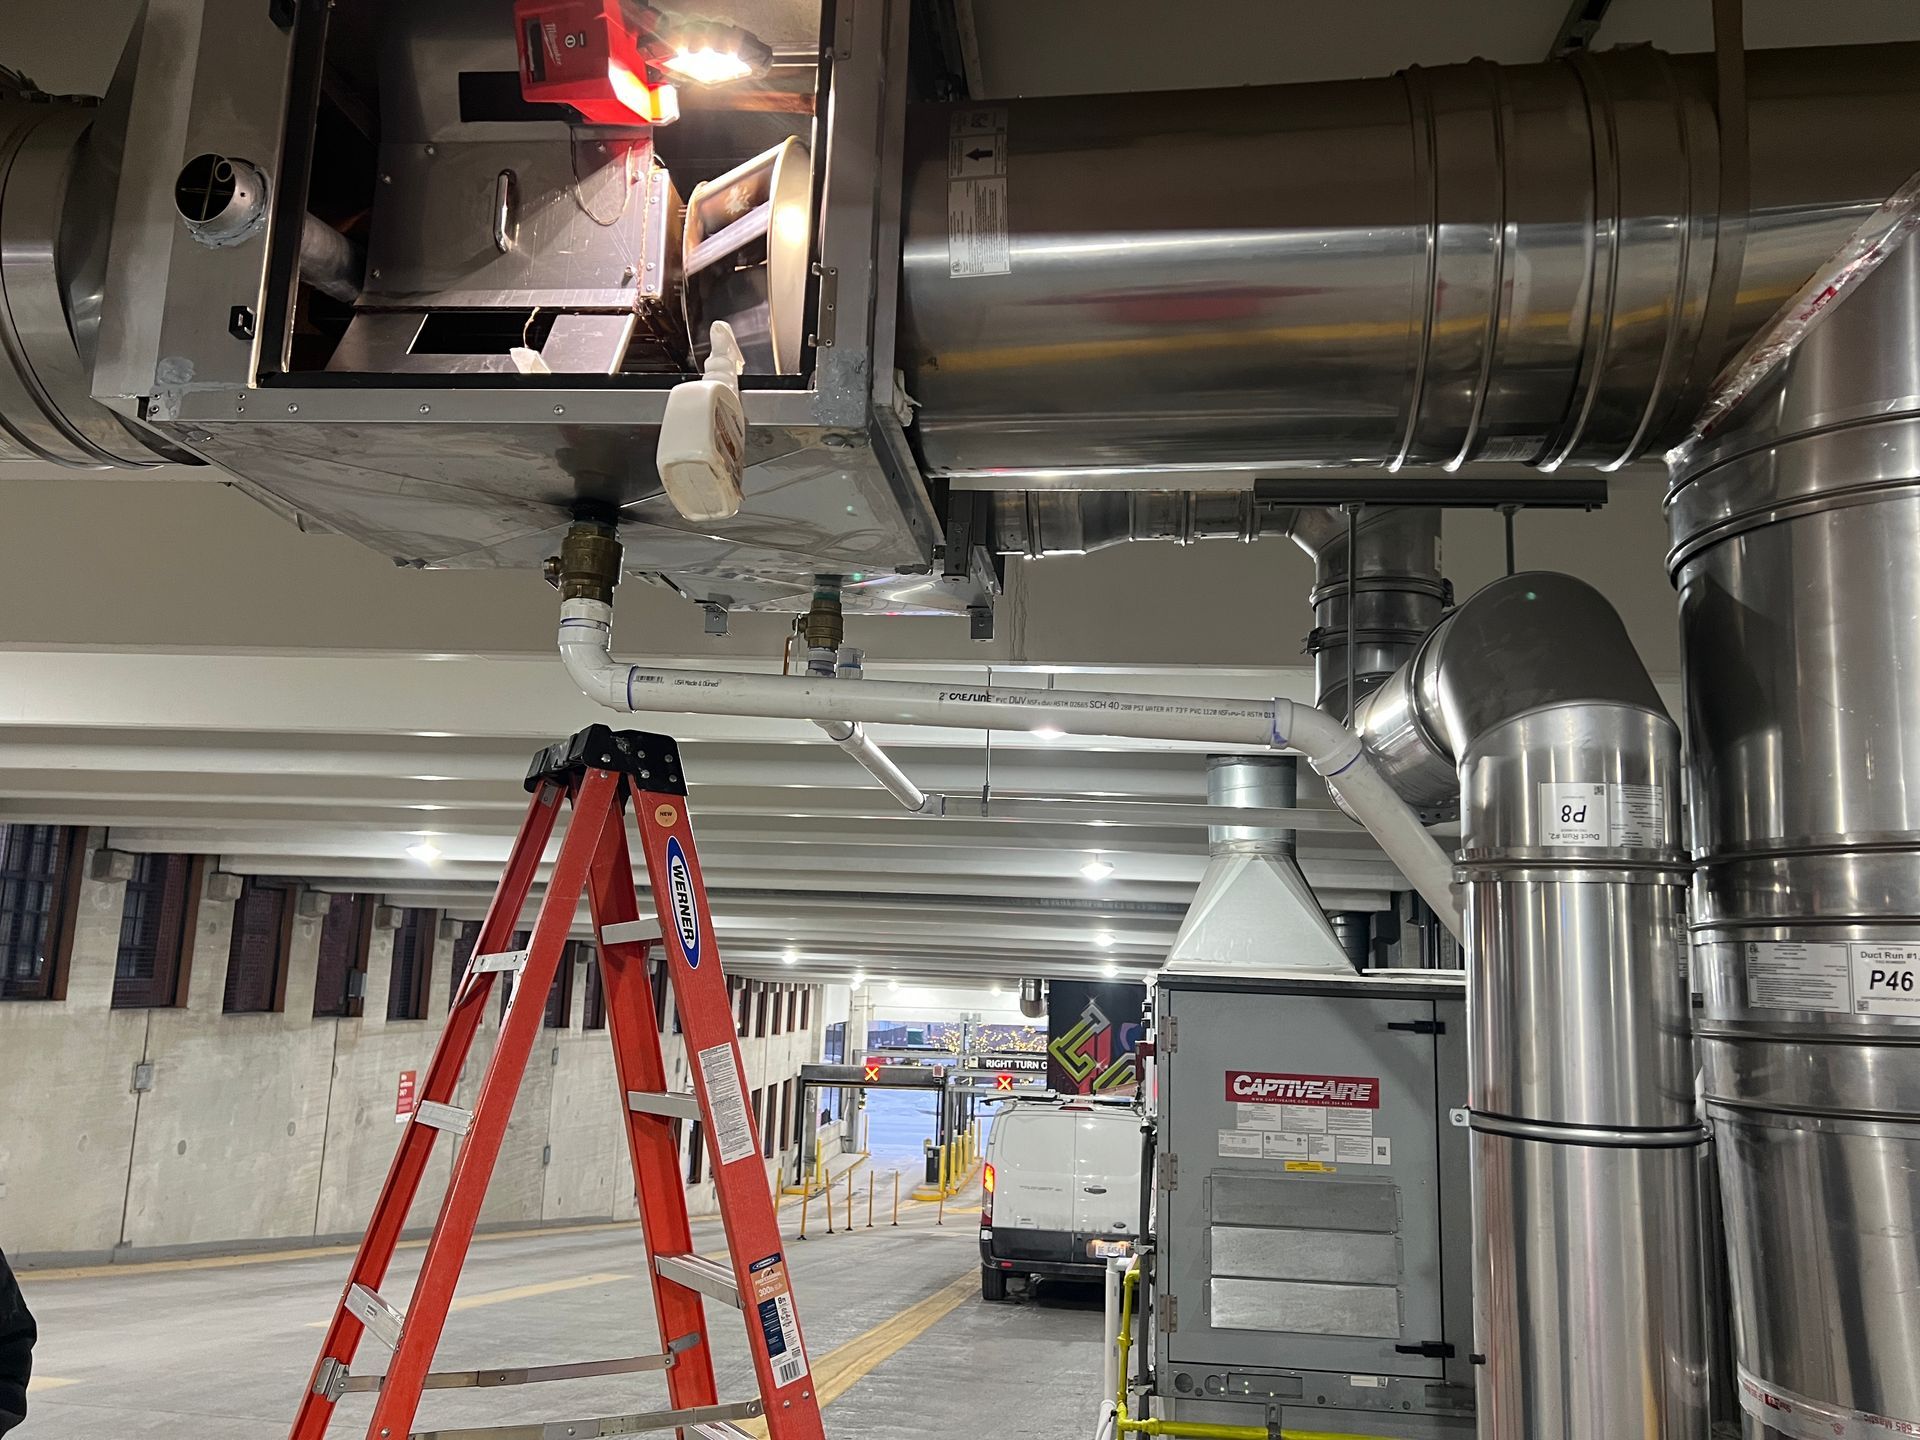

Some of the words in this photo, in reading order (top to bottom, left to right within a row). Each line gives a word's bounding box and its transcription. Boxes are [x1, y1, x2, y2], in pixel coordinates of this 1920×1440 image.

[1089, 700, 1107, 709] SCH
[1108, 701, 1120, 710] 40
[1133, 704, 1144, 712] PSI
[1145, 705, 1165, 713] WATER
[1189, 707, 1201, 715] PVC
[1203, 708, 1217, 716] 1120
[1560, 804, 1587, 823] P8
[672, 864, 695, 941] WERNER
[1860, 951, 1882, 959] Duct
[1884, 951, 1904, 960] Run
[1869, 970, 1914, 992] P46
[985, 1059, 1013, 1069] RIGHT
[1015, 1060, 1039, 1070] TURN
